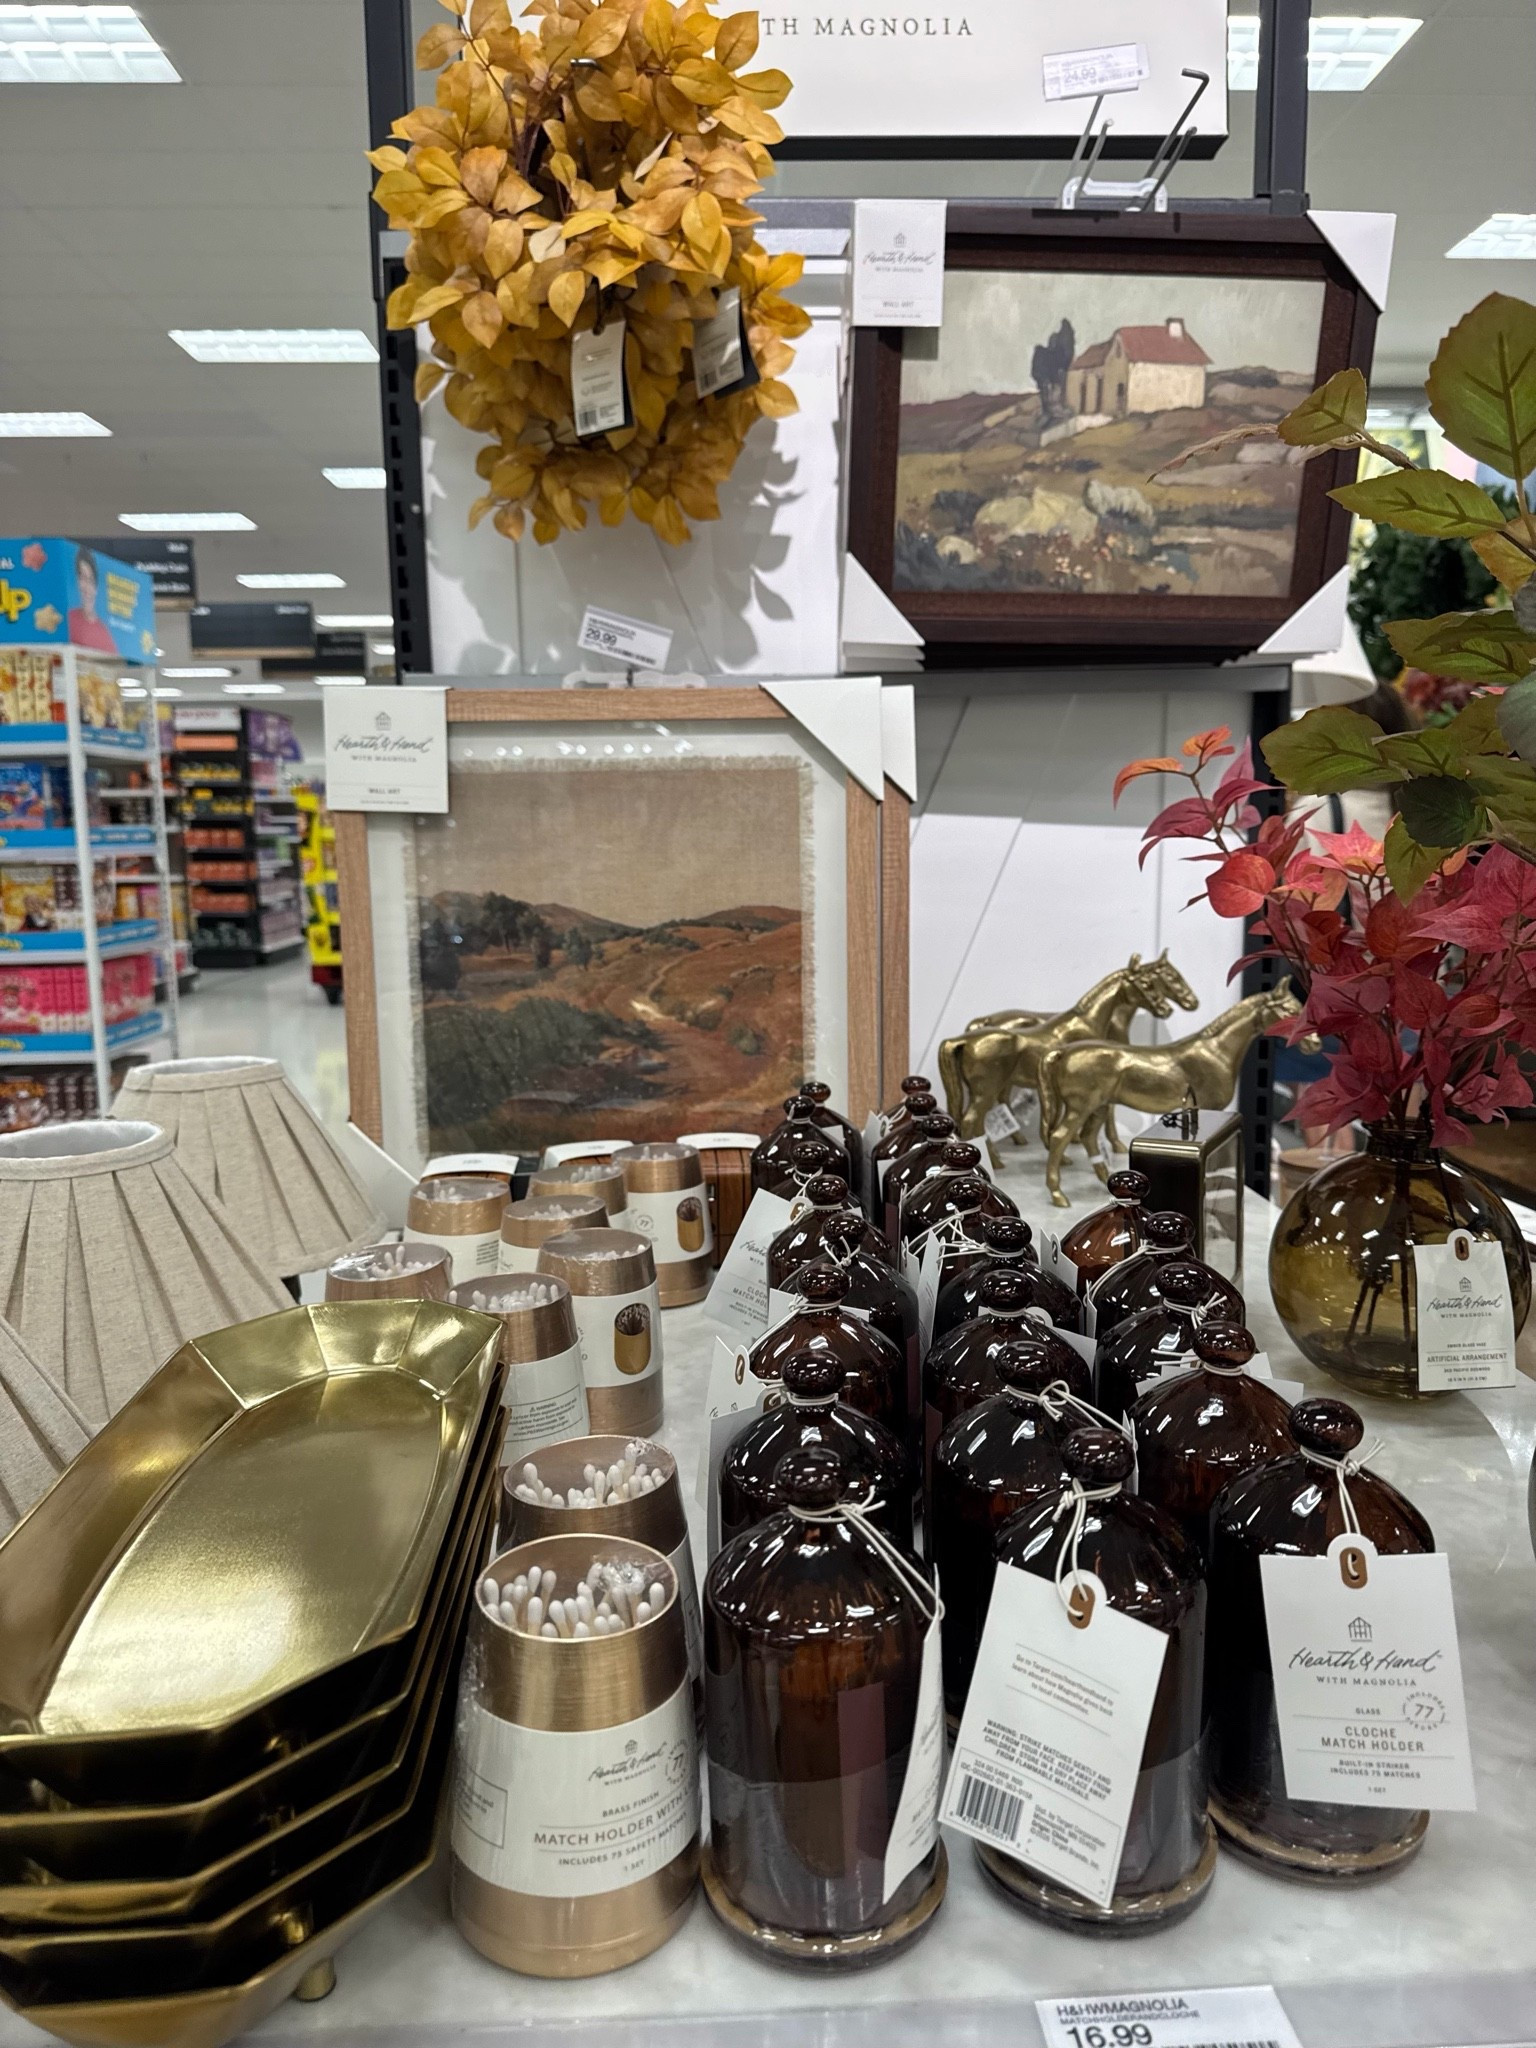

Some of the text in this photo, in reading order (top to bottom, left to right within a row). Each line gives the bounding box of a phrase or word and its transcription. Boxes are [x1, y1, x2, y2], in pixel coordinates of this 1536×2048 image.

[762, 17, 973, 36] TH MAGNOLIA
[1064, 67, 1097, 83] 24.99
[747, 1286, 768, 1300] CLOCH
[1427, 1294, 1503, 1311] Hearth & Hand
[1427, 1352, 1507, 1363] ARTIFICIAL ARRANGEMENT
[1289, 1647, 1440, 1672] Hearth & Hand
[1316, 1675, 1417, 1687] WITH MAGNOLIA
[1355, 1707, 1381, 1716] GLASS
[1414, 1703, 1434, 1719] 77
[1344, 1726, 1397, 1739] CLOCHE
[1321, 1737, 1424, 1752] MATCH HOLDER
[588, 1757, 632, 1781] Hearth
[636, 1741, 667, 1768] Hand
[982, 1725, 1000, 1739] AWAY
[1000, 1734, 1019, 1749] FROM
[1020, 1743, 1038, 1758] YOUR
[1056, 1762, 1074, 1776] KEEP
[1073, 1770, 1092, 1785] AWAY
[1092, 1779, 1111, 1795] FROM
[995, 1748, 1014, 1763] FROM
[1014, 1758, 1053, 1782] FLAMMABLE
[1018, 1734, 1041, 1751] STRIKE
[1042, 1745, 1072, 1766] MATCHES
[1072, 1761, 1097, 1778] GENTLY
[1097, 1773, 1112, 1786] AND
[1339, 1758, 1411, 1770] BUILT-IN STRIKER
[1018, 1751, 1039, 1767] STORE
[1039, 1762, 1048, 1771] IN
[1053, 1768, 1068, 1781] DRY
[1067, 1775, 1088, 1791] PLACE
[1088, 1786, 1107, 1801] AWAY
[1330, 1767, 1370, 1778] INCLUDES
[1383, 1769, 1421, 1779] MATCHES
[602, 1791, 659, 1817] BRASS FINISH
[534, 1792, 682, 1846] MATCH HOLDER WITH
[558, 1852, 609, 1866] INCLUDES
[625, 1838, 656, 1856] SAFETY
[1057, 1998, 1189, 2016] H&HWMAGNOLIA
[1066, 2023, 1153, 2048] 16.99
